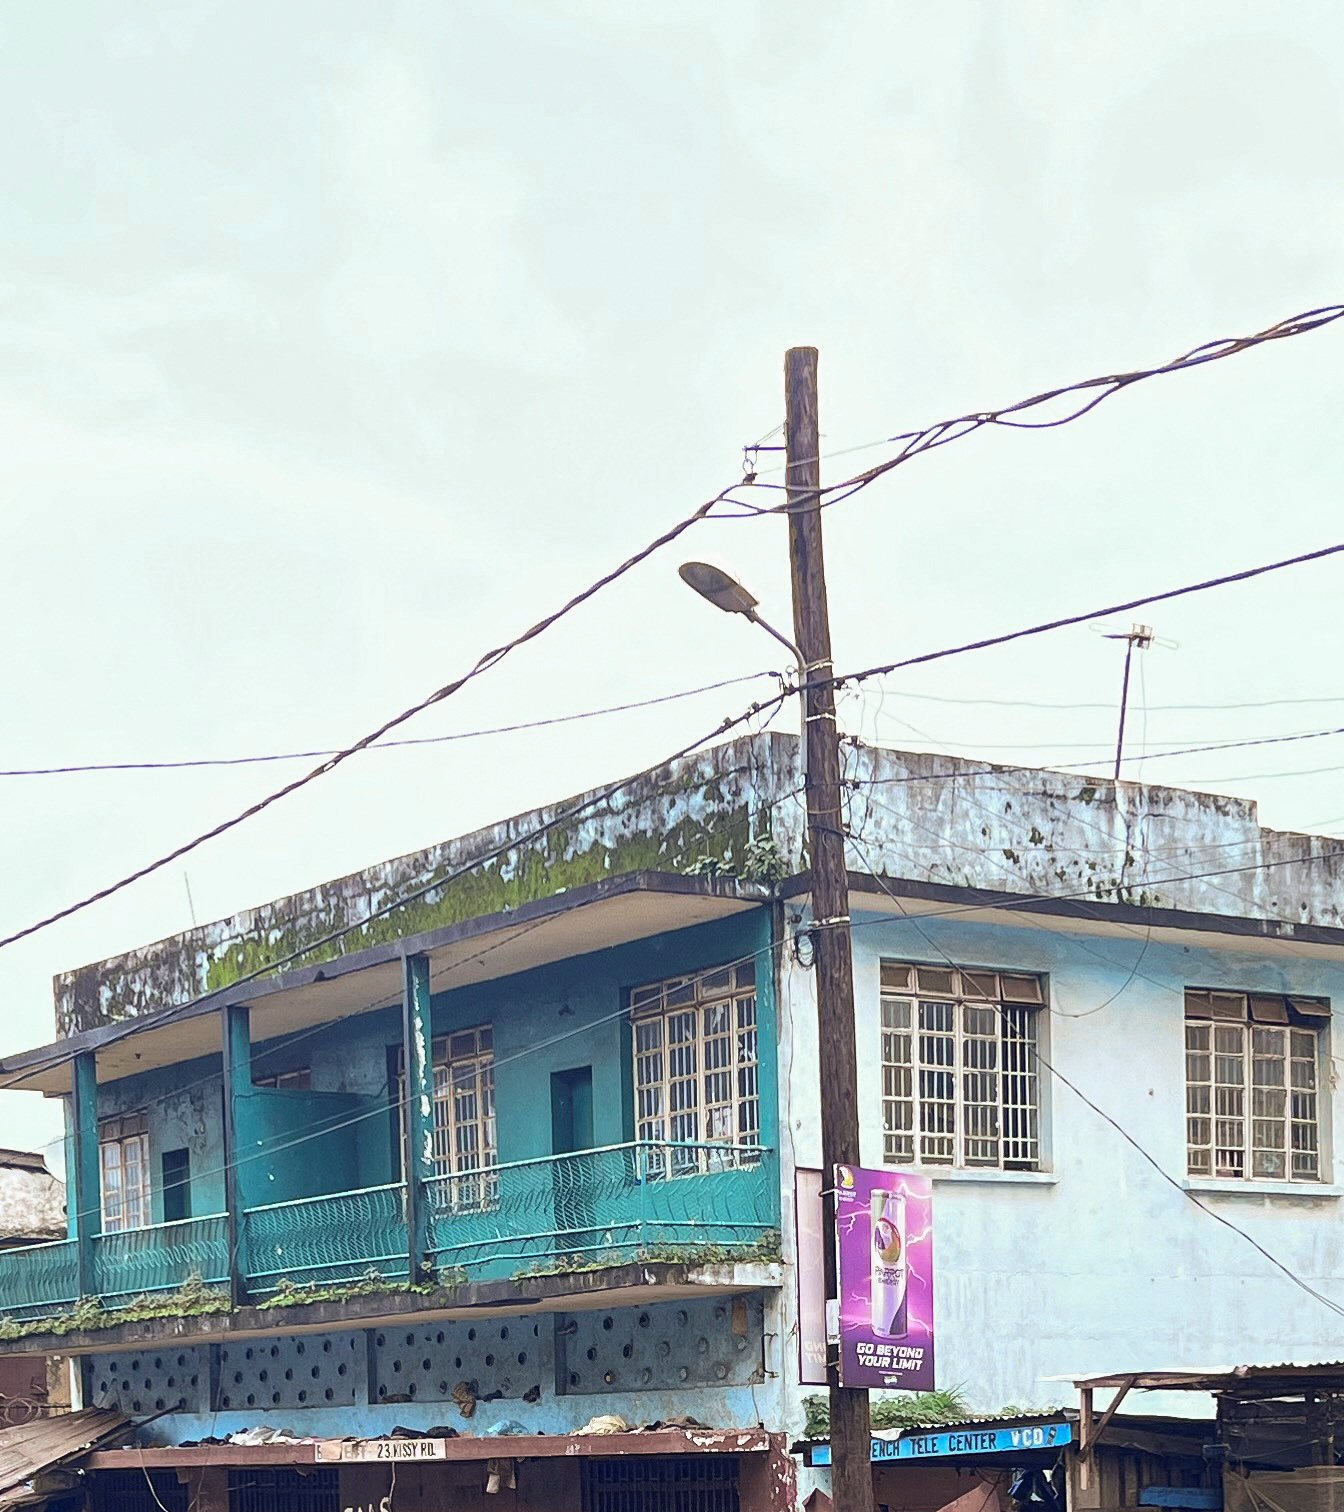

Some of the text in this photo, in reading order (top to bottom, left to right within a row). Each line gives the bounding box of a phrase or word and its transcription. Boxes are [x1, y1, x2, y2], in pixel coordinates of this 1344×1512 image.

[856, 1342, 924, 1359] GO BEYOND
[858, 1355, 923, 1371] YOUR LIMIT
[909, 1436, 939, 1455] TELE
[948, 1432, 996, 1452] CENTER
[1010, 1427, 1044, 1449] VCD
